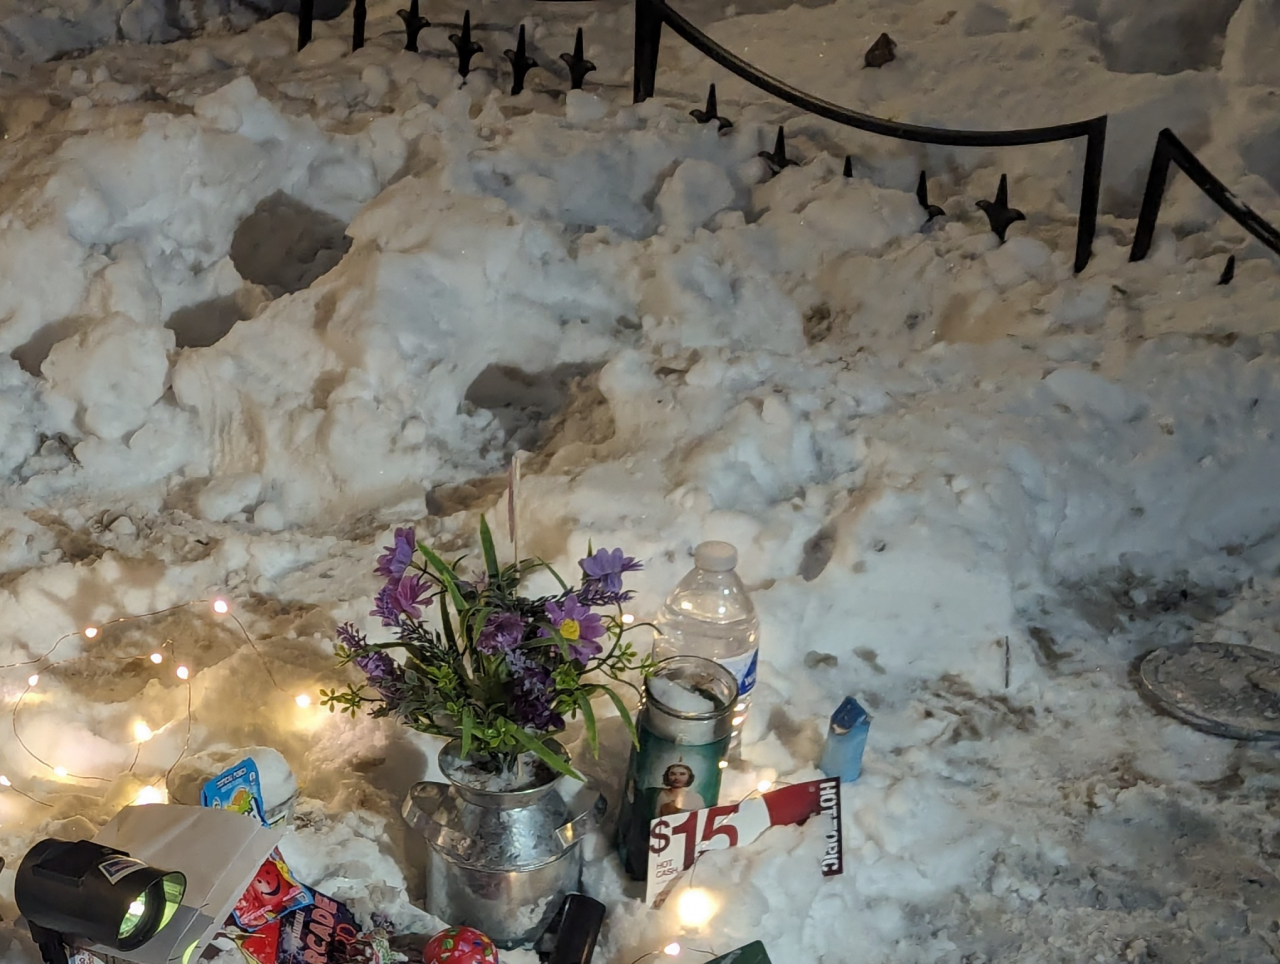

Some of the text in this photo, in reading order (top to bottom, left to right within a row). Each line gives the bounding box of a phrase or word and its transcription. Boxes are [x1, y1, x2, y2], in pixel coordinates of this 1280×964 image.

[819, 781, 838, 816] HOT
[649, 804, 740, 872] $15
[655, 866, 679, 879] CASH
[656, 858, 674, 870] HOT
